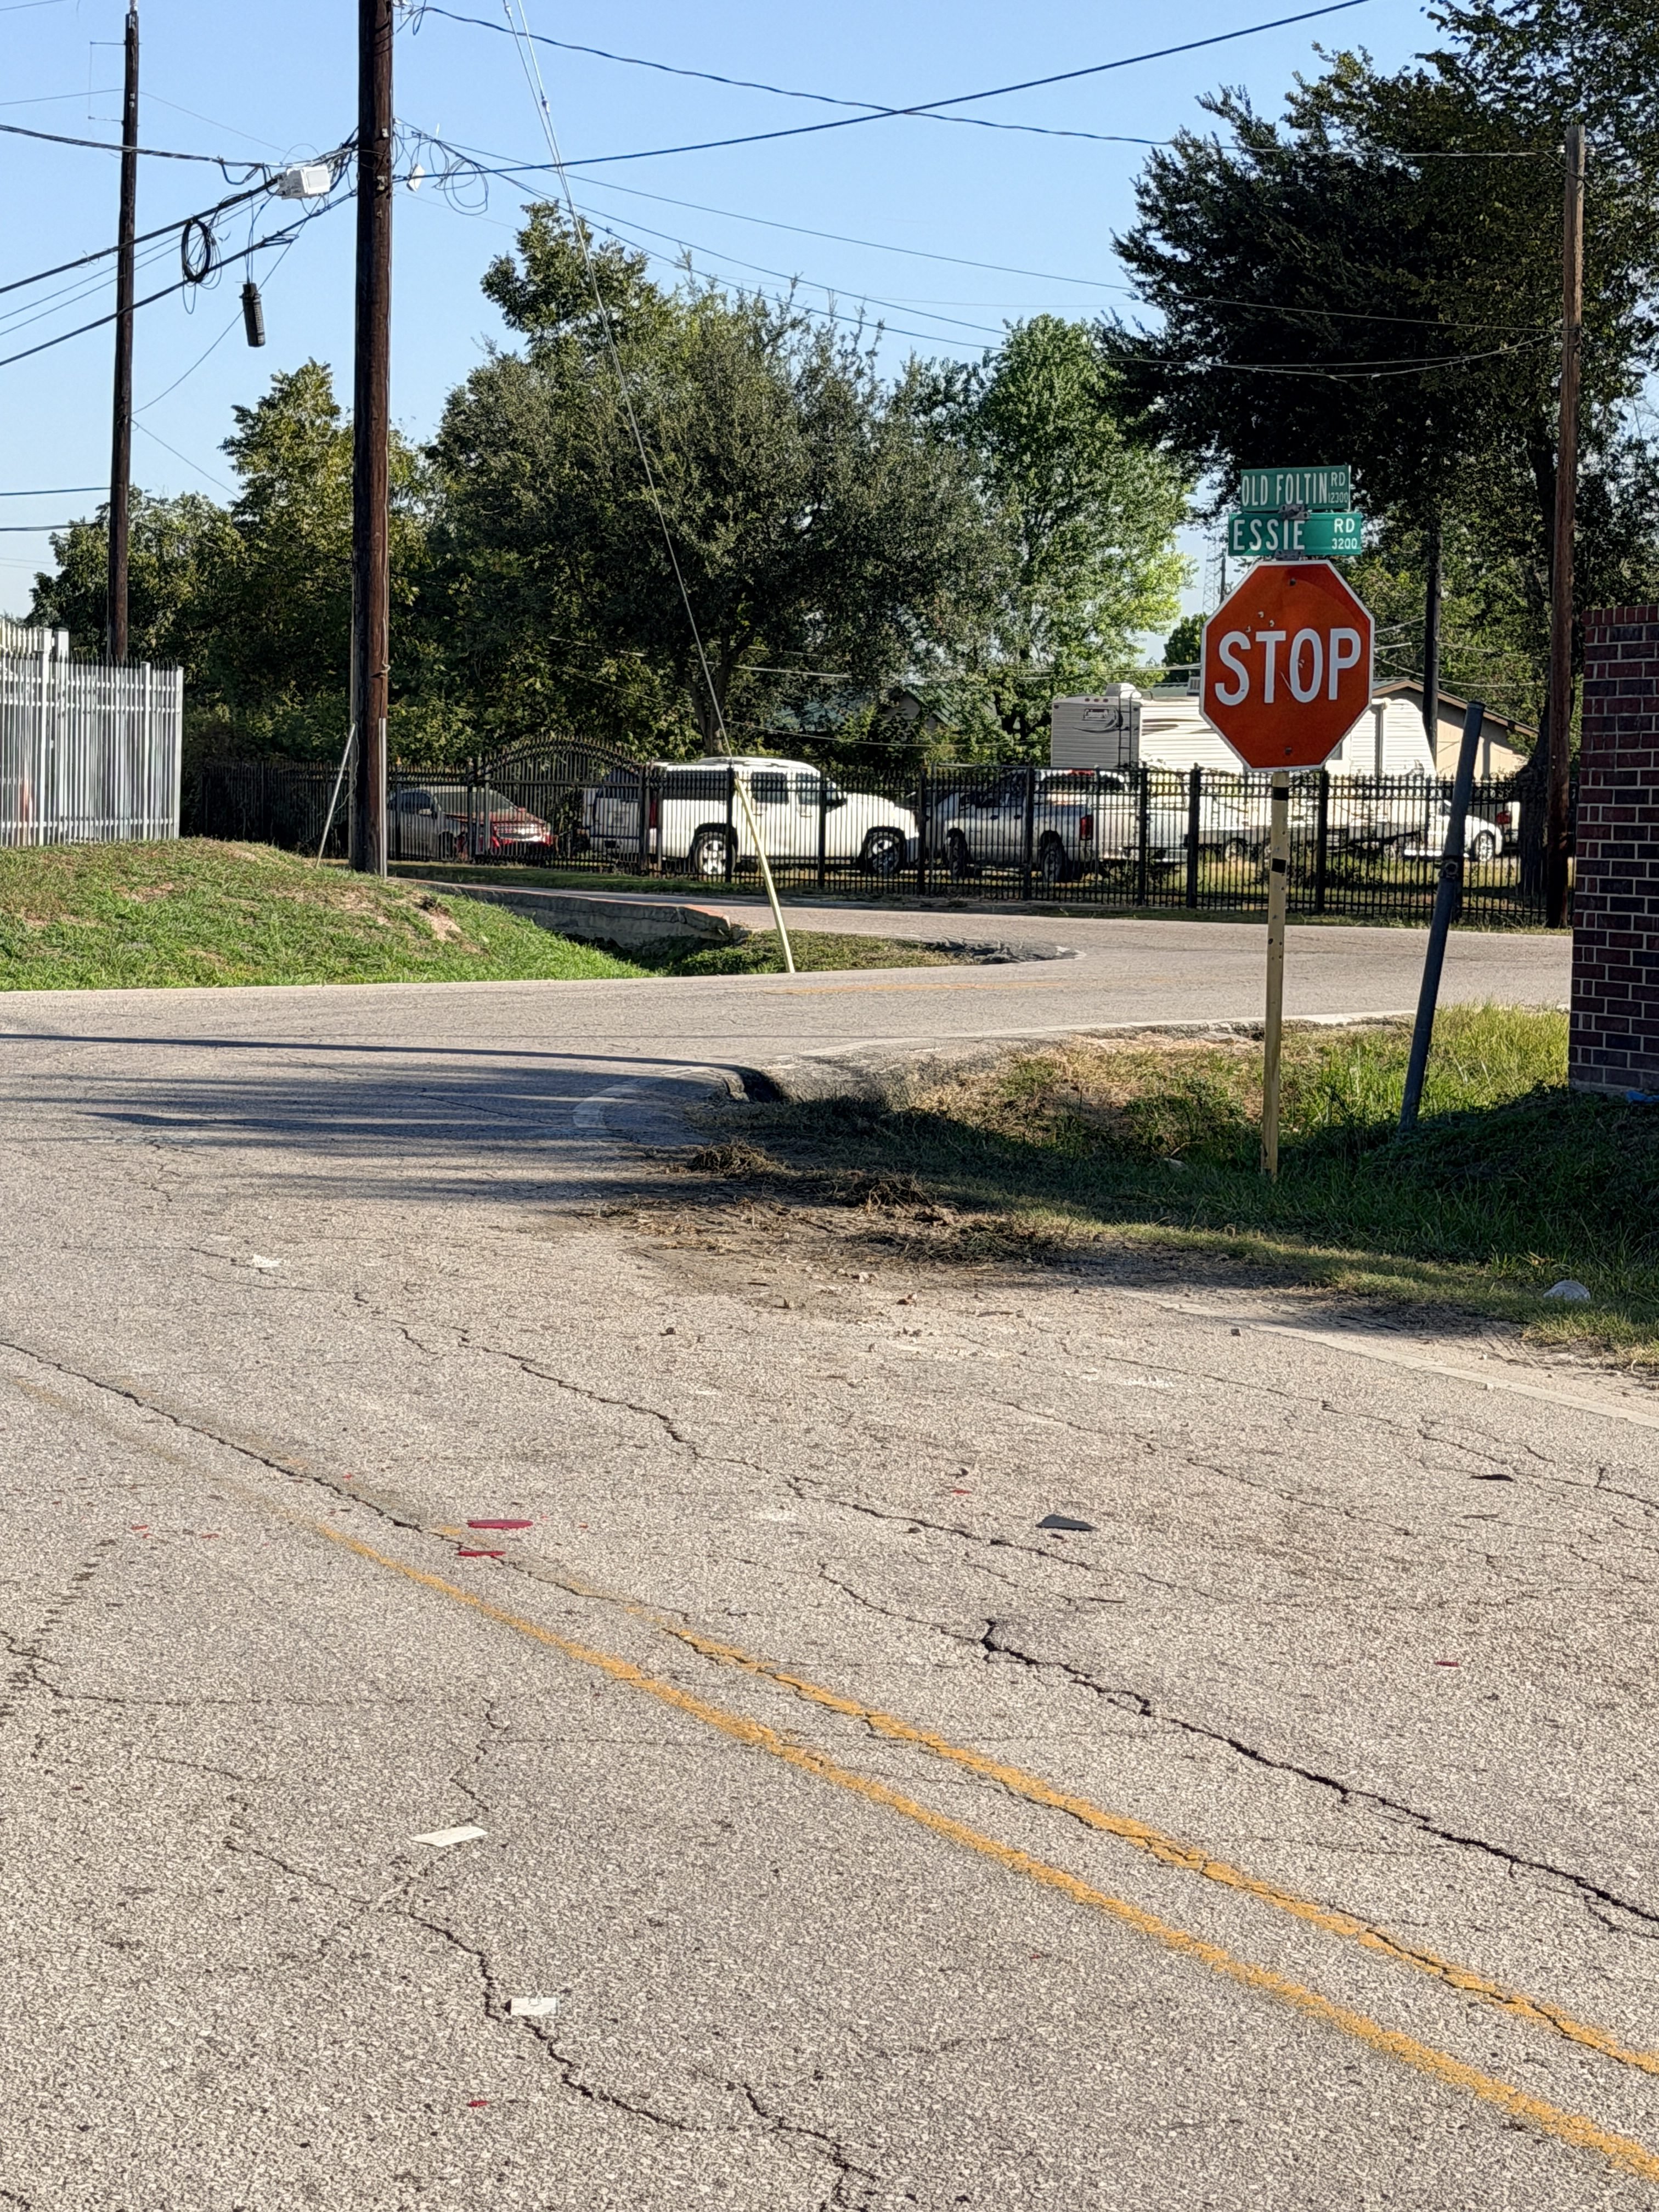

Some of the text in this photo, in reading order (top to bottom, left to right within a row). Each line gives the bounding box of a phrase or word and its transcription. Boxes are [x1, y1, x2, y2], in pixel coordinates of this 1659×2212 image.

[1242, 471, 1346, 507] OLD FOLTIN RD
[1328, 491, 1348, 504] 12300
[1233, 517, 1355, 551] ESSIE RD
[1331, 537, 1358, 550] 3200
[1215, 627, 1362, 706] STOP
